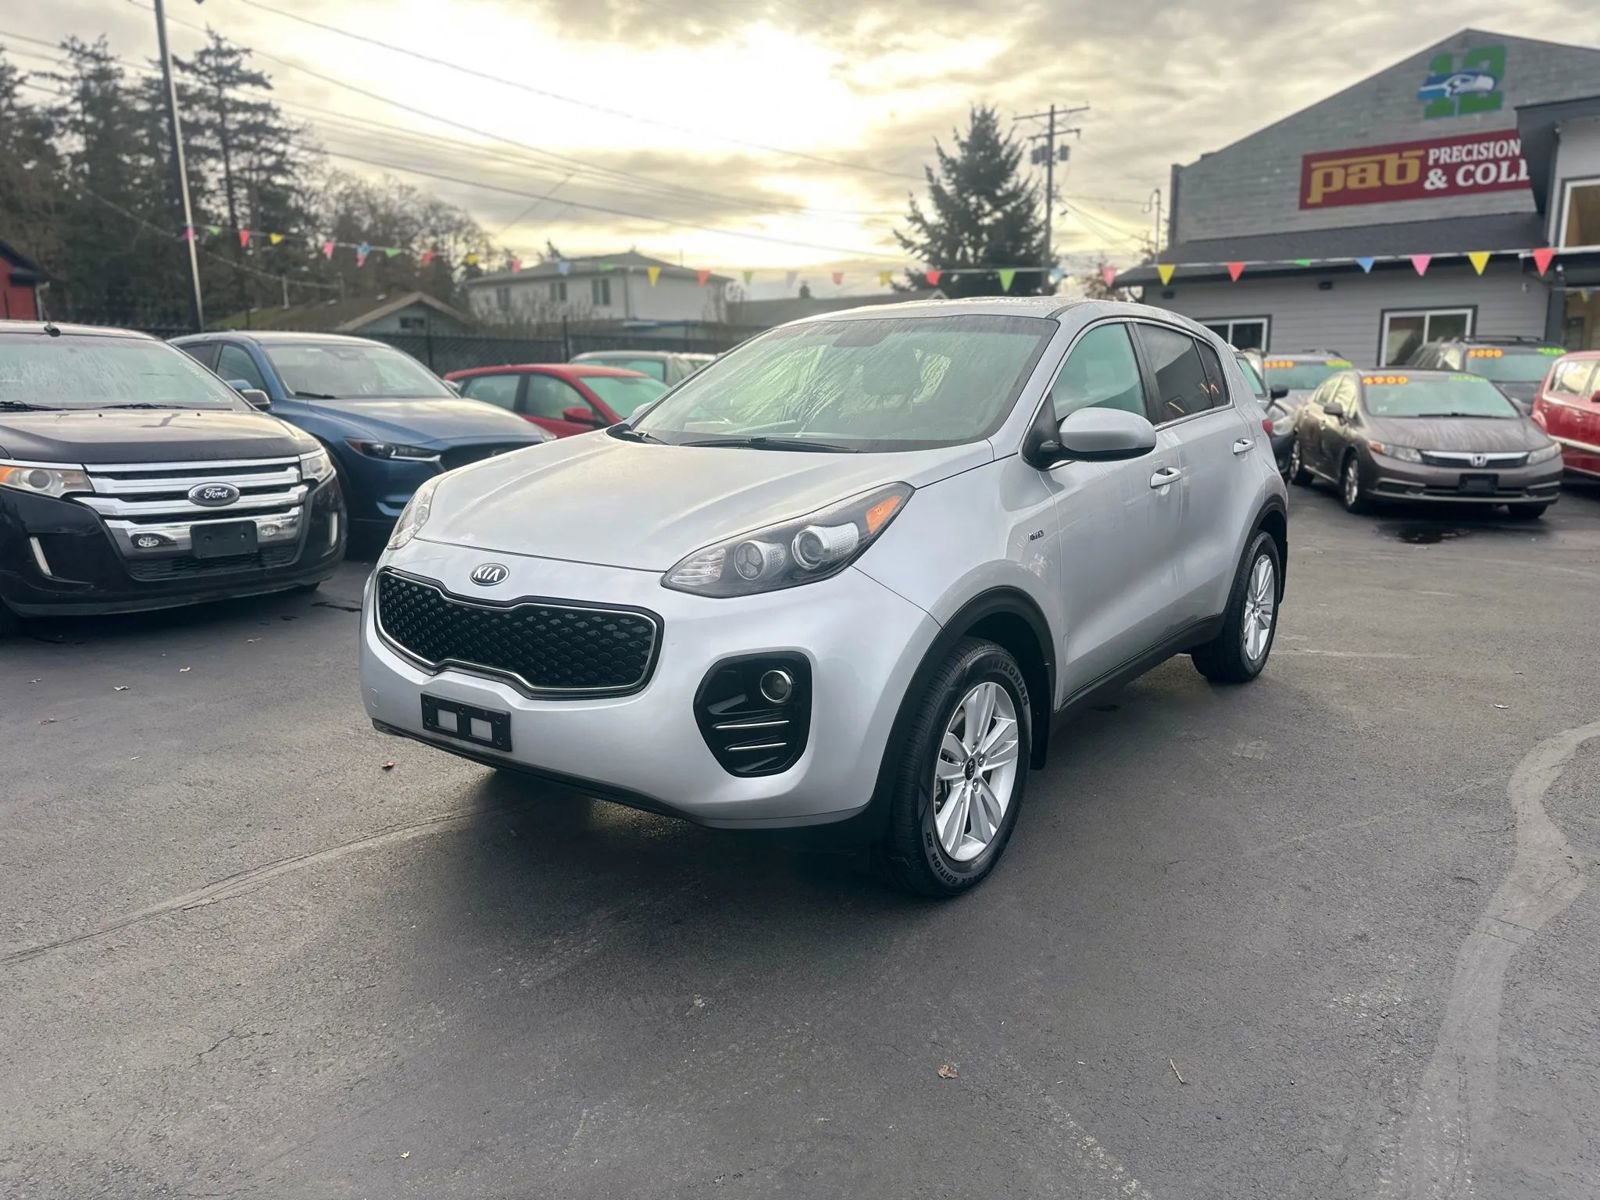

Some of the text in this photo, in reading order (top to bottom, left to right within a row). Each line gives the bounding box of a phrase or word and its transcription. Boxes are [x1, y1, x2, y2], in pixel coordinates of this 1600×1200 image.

[1428, 138, 1522, 166] PRECISION
[1306, 150, 1426, 204] pab
[1424, 168, 1448, 190] &
[203, 487, 229, 499] Ford
[473, 566, 501, 581] KIA
[990, 659, 1029, 706] RIZONIAN
